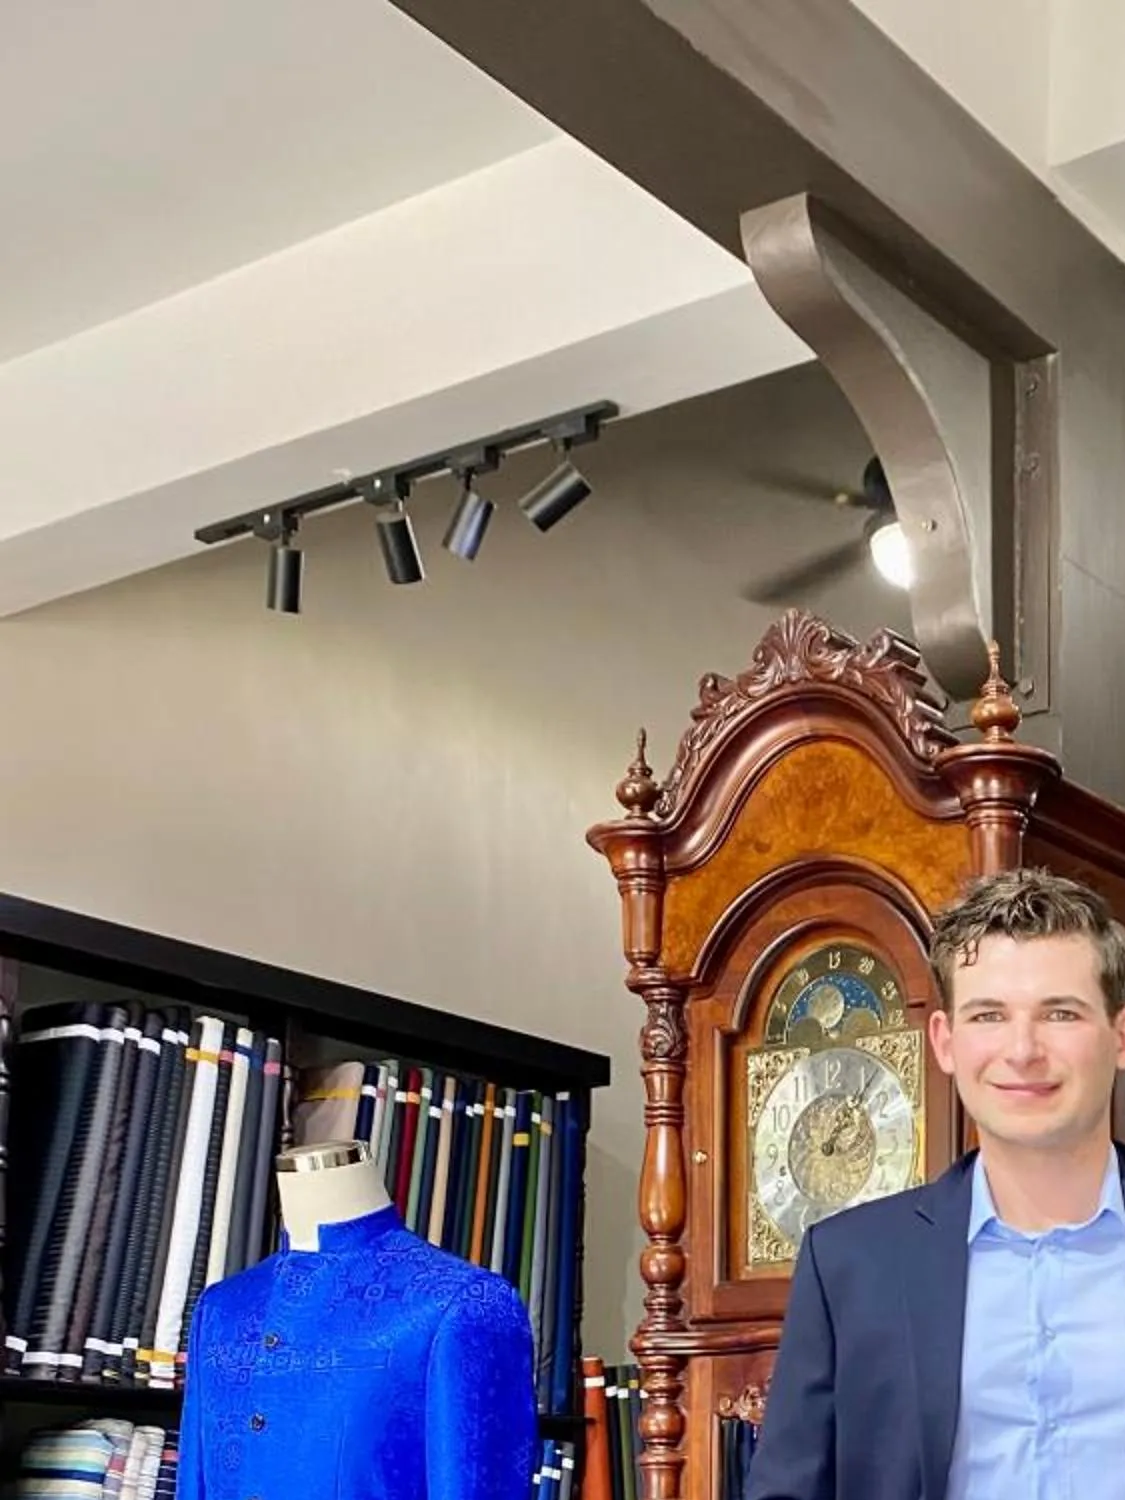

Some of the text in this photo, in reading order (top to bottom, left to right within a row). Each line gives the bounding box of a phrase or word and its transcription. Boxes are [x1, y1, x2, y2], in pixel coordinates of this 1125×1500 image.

[794, 1075, 808, 1100] 11
[824, 1059, 842, 1089] 12
[877, 1090, 889, 1118] 2
[771, 1104, 791, 1132] 10
[767, 1143, 779, 1169] 9
[774, 1179, 786, 1206] 8
